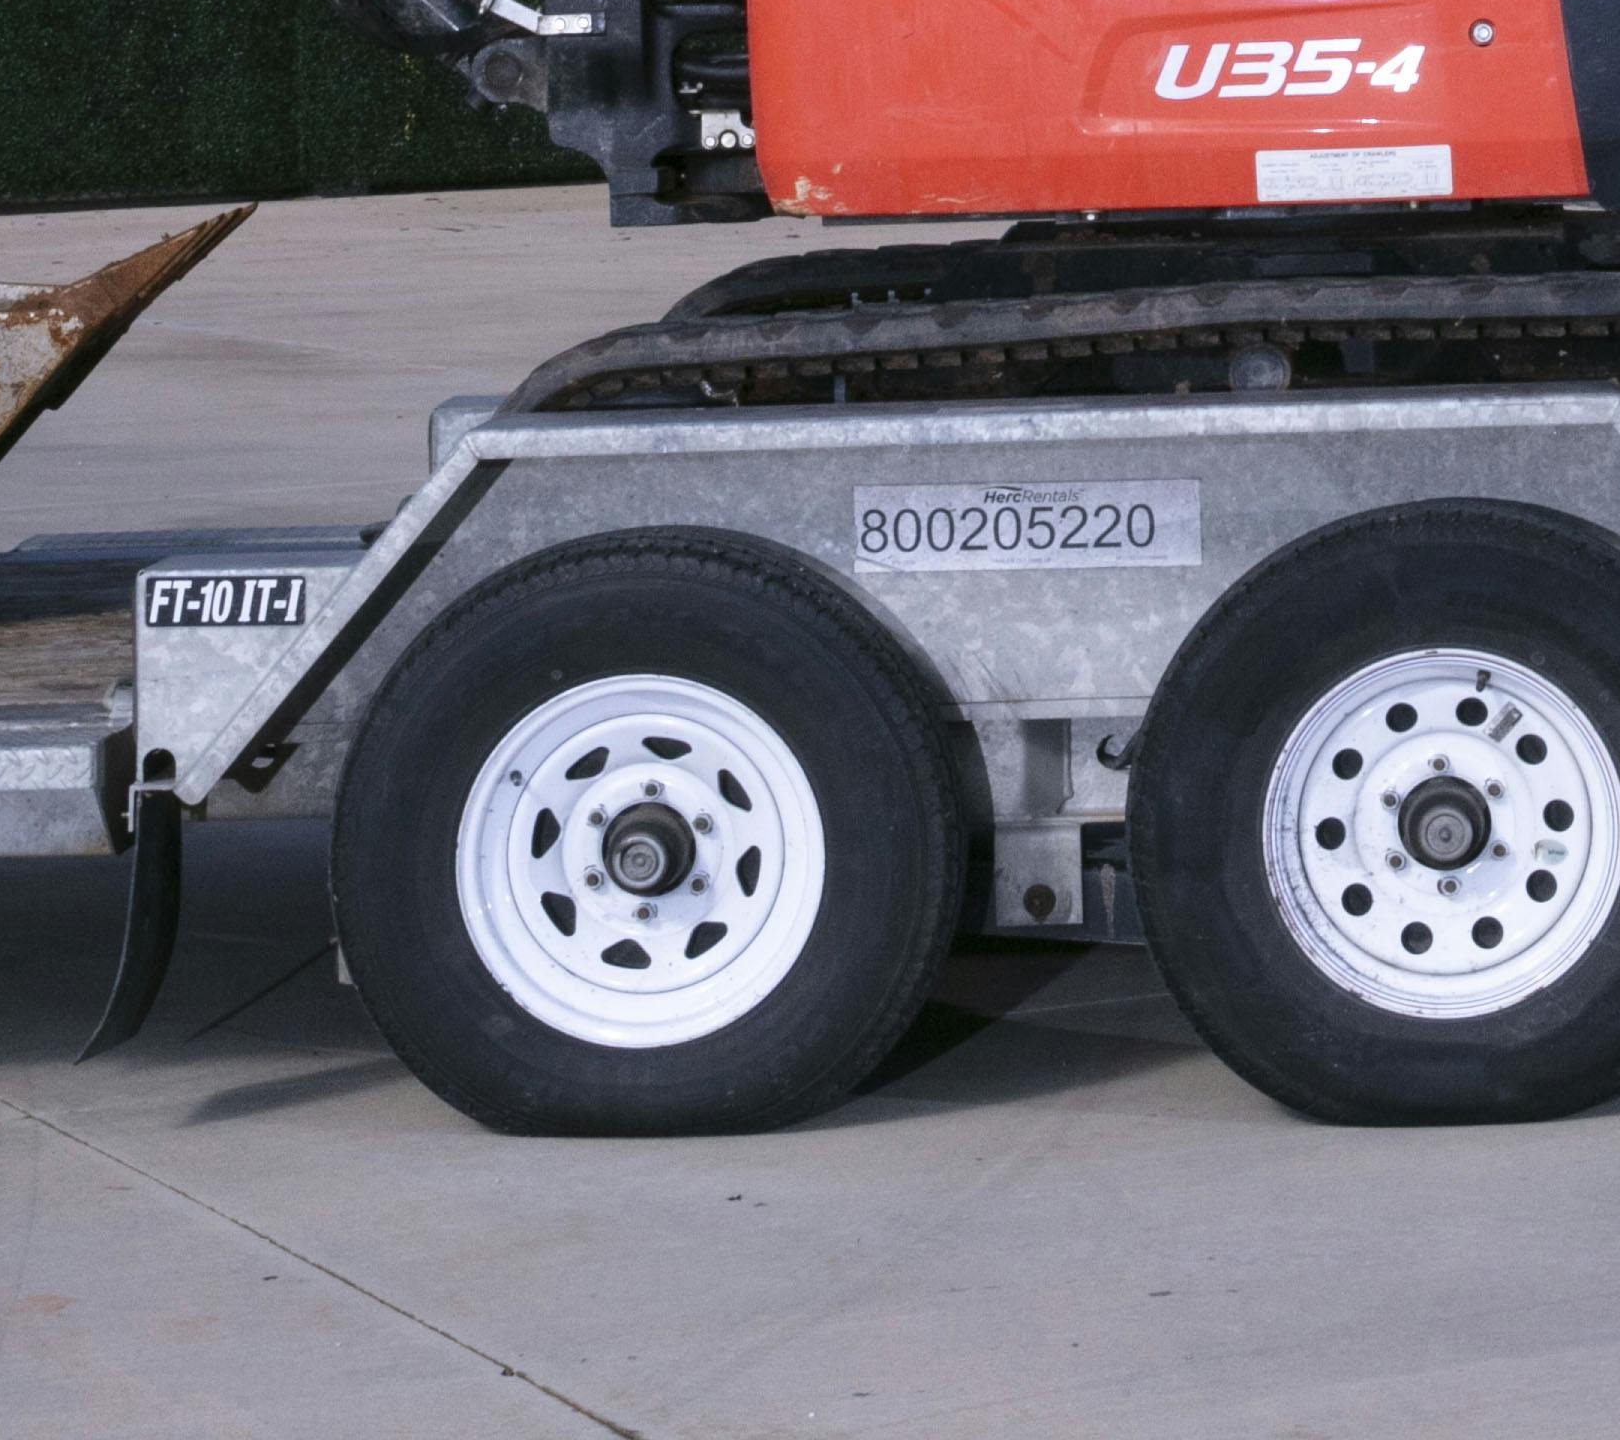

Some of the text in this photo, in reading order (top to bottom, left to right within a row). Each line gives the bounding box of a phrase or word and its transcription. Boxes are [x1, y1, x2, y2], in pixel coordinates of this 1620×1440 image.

[1155, 38, 1426, 100] U35-4
[983, 487, 1080, 504] HercRentals
[860, 503, 1156, 553] 800205220
[149, 579, 234, 624] FT-10
